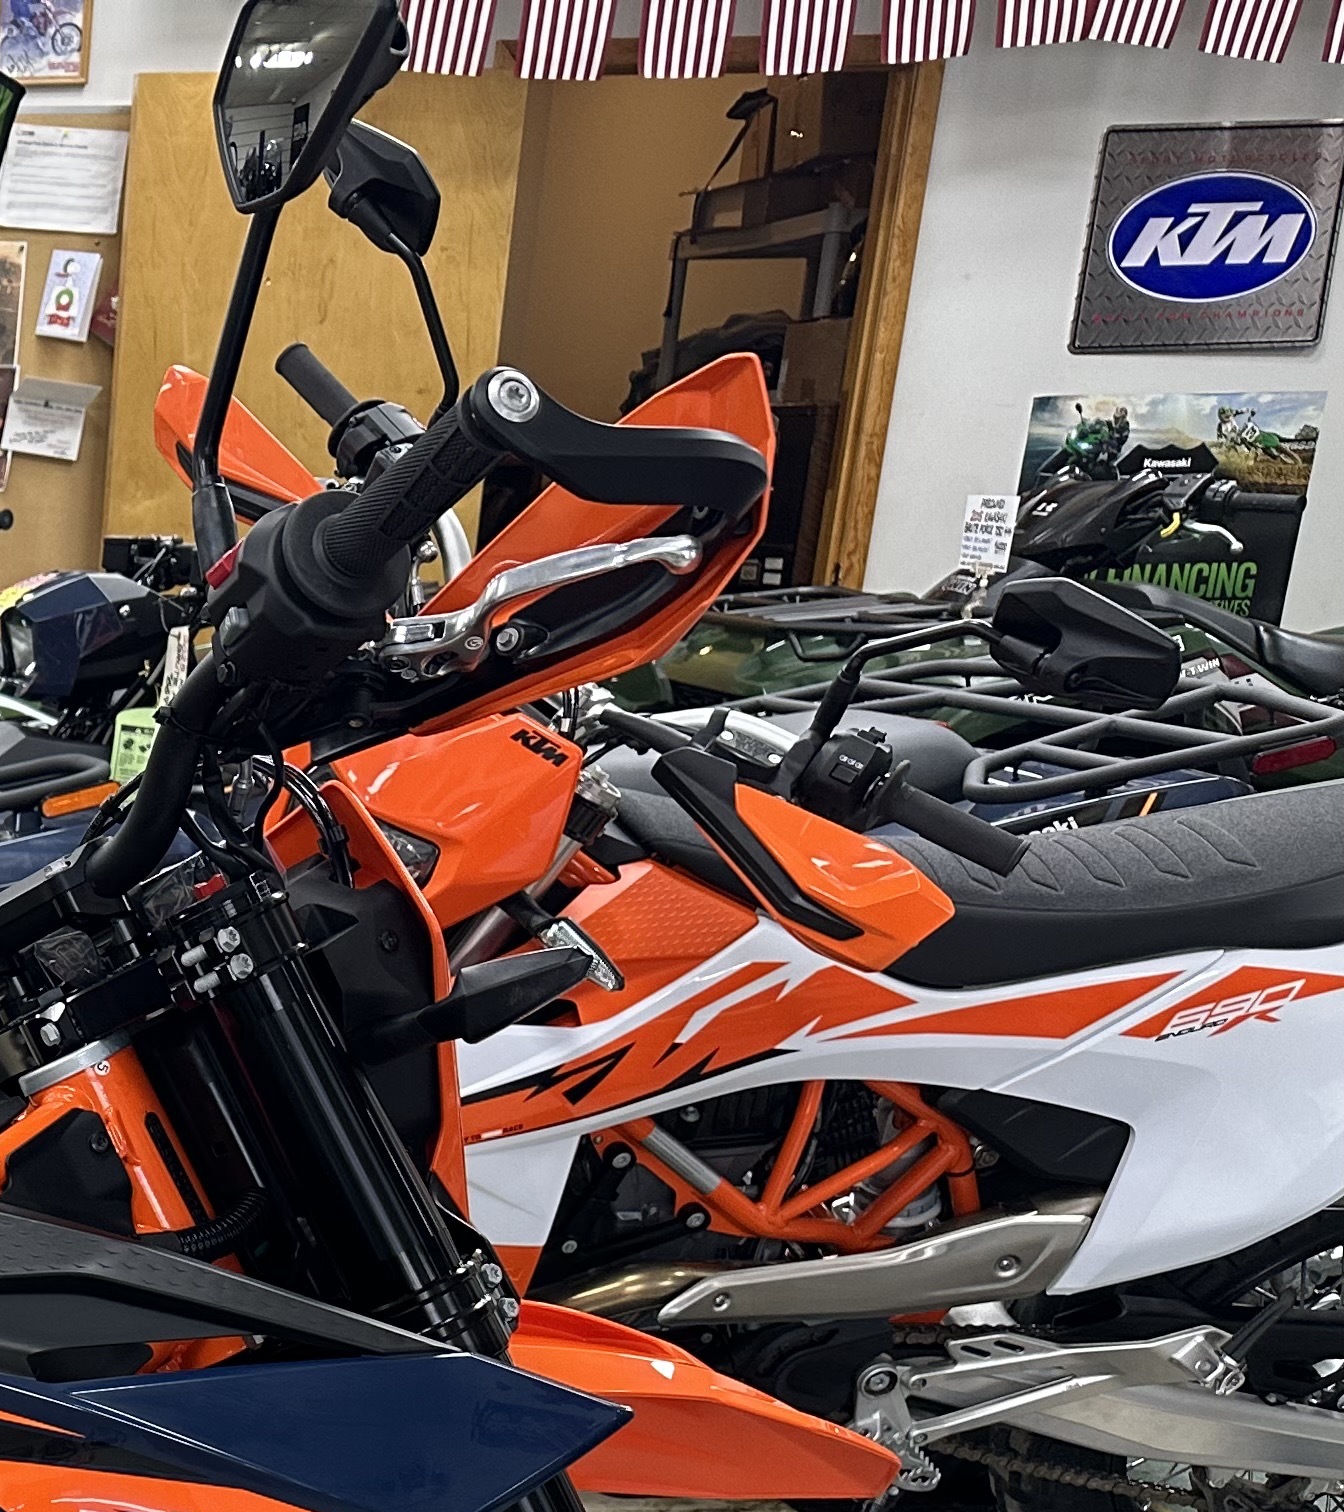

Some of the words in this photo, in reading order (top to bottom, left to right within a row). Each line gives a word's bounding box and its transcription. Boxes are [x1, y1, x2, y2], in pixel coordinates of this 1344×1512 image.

[1119, 201, 1307, 268] KTM
[1199, 308, 1306, 321] CHAMPIONS
[1143, 456, 1192, 469] Kawasaki
[1104, 561, 1258, 599] FINANCING
[509, 728, 571, 768] KTM
[1164, 977, 1308, 1030] 690
